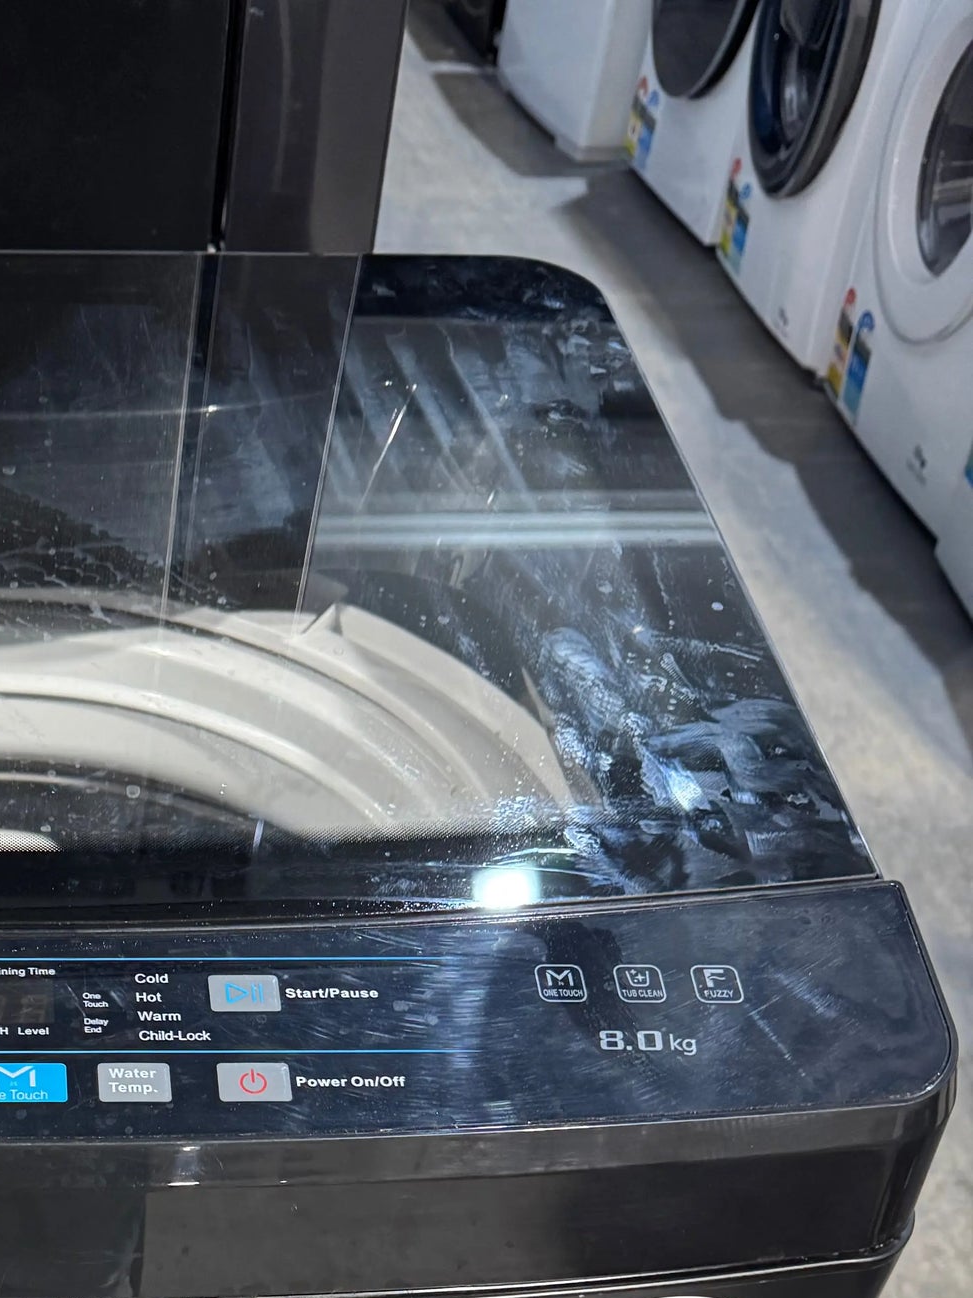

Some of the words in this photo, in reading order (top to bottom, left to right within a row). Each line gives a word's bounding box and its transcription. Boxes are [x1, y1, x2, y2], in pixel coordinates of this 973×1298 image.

[28, 967, 56, 976] Time
[134, 973, 169, 984] Cold
[82, 992, 102, 1000] One
[135, 992, 162, 1003] Hot
[285, 987, 379, 999] Start/Pause
[543, 989, 559, 998] ONE
[559, 989, 584, 998] TOUCH
[622, 989, 638, 998] TUB
[638, 989, 663, 998] CLEAN
[704, 989, 734, 999] FUZZY
[83, 1000, 109, 1009] Touch
[137, 1011, 182, 1022] Warm
[83, 1018, 109, 1028] Delay
[17, 1026, 50, 1036] Level
[84, 1026, 103, 1034] End
[138, 1030, 212, 1042] Child-Lock
[599, 1030, 663, 1051] 8.0
[669, 1034, 697, 1056] kg
[108, 1068, 156, 1079] Water
[295, 1075, 348, 1088] Power
[350, 1075, 406, 1088] On/Off
[108, 1082, 159, 1094] Temp.
[10, 1089, 49, 1101] Touch
